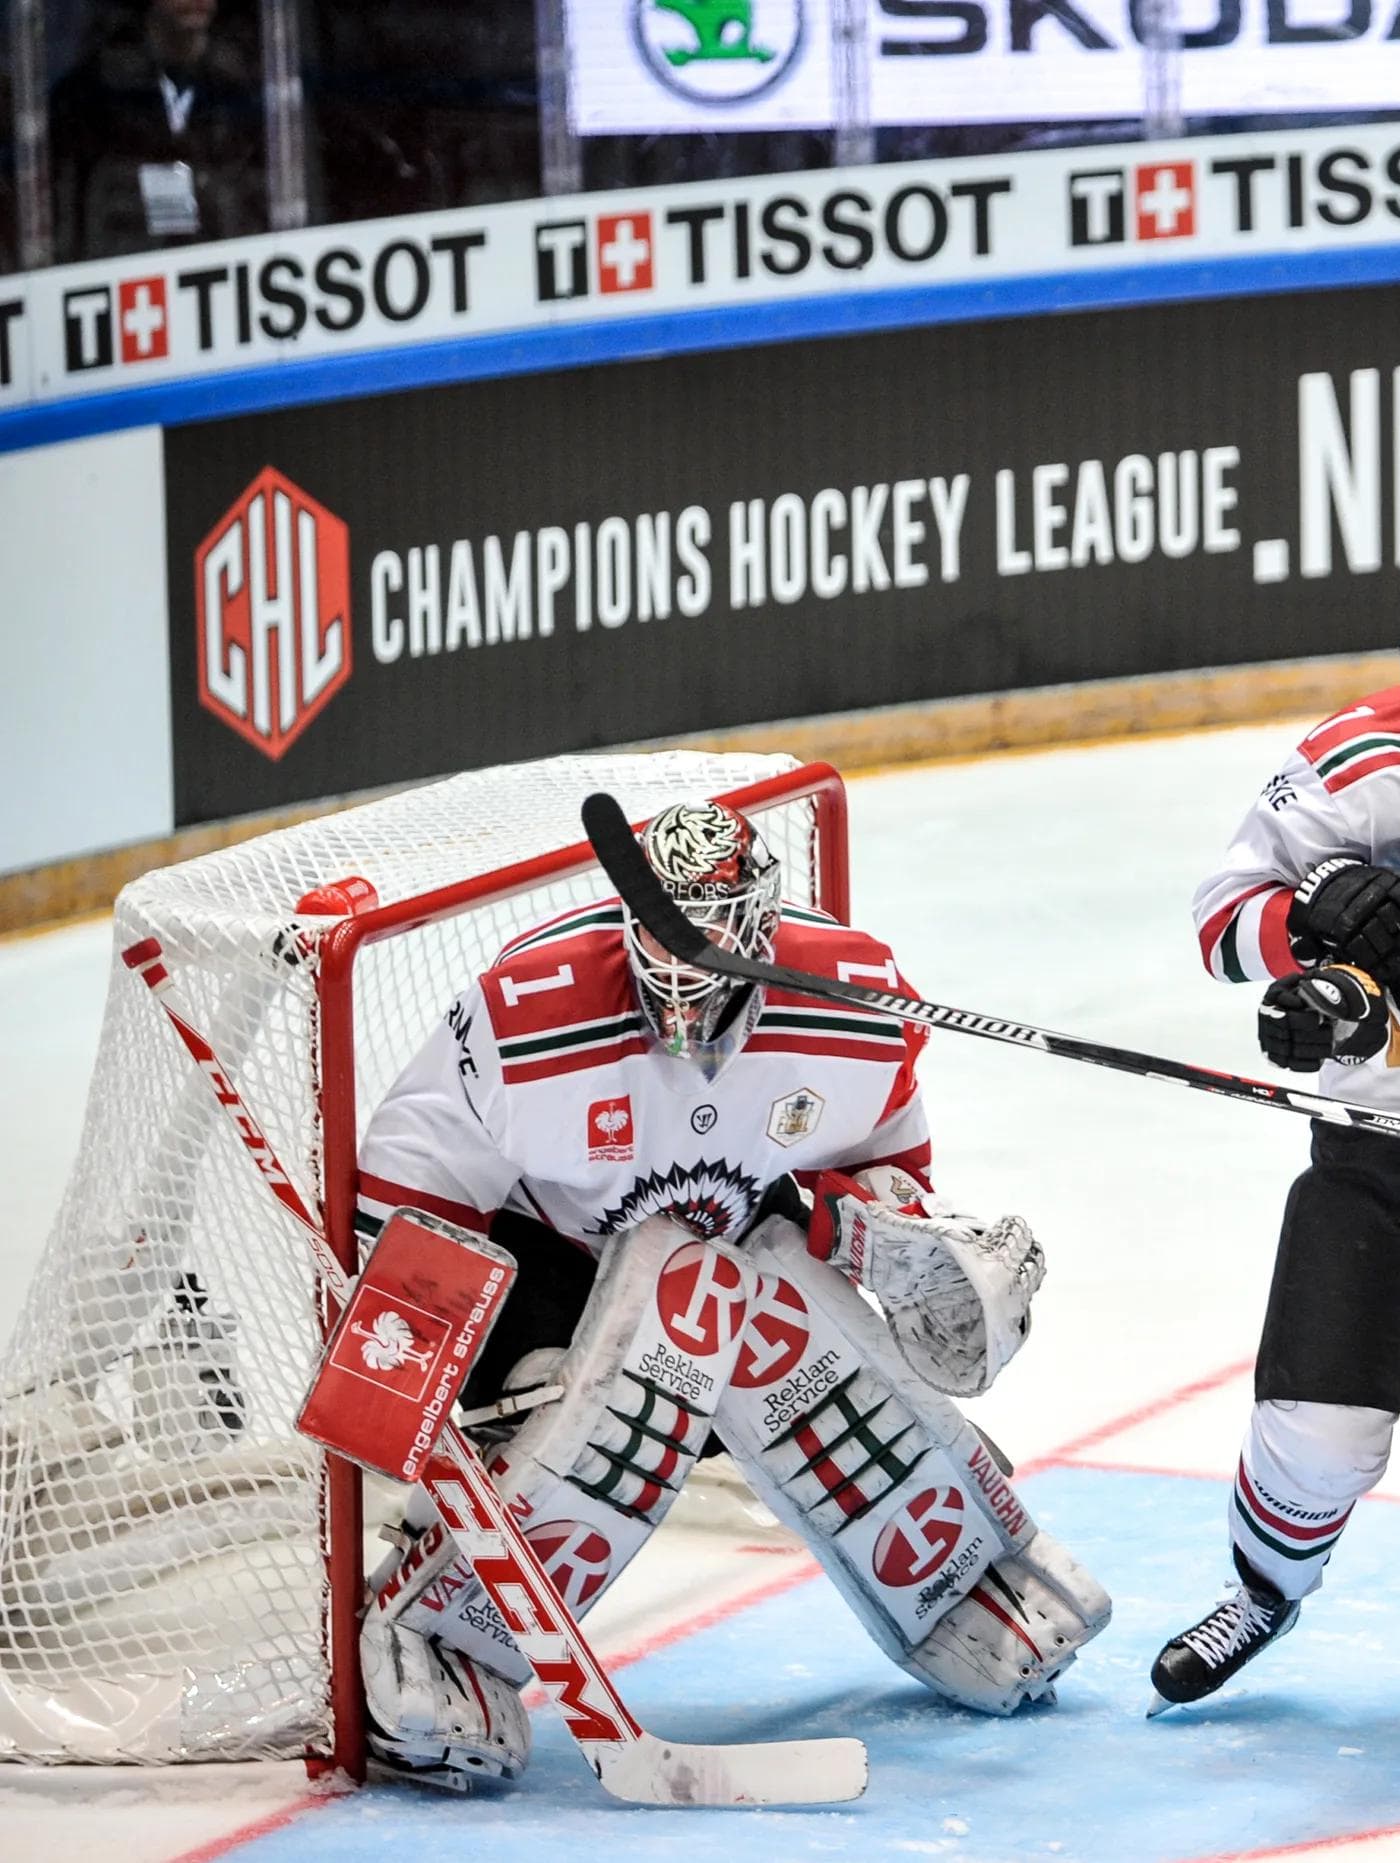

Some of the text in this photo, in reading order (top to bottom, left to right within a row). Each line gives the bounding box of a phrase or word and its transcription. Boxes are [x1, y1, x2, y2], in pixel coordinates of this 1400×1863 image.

[666, 178, 1013, 284] TISSOT
[178, 230, 487, 353] TISSOT
[370, 503, 712, 664] CHAMPIONS
[729, 473, 971, 609] HOCKEY
[995, 444, 1242, 577] LEAGUE
[203, 484, 343, 736] CHL
[499, 963, 575, 1008] 1
[836, 958, 899, 989] 1
[402, 1266, 505, 1476] engelbert strauss
[639, 1353, 701, 1400] Service
[649, 1342, 715, 1392] Reklam
[763, 1349, 841, 1414] Reklam
[763, 1368, 839, 1433] Service
[967, 1445, 1029, 1537] VAUGHN
